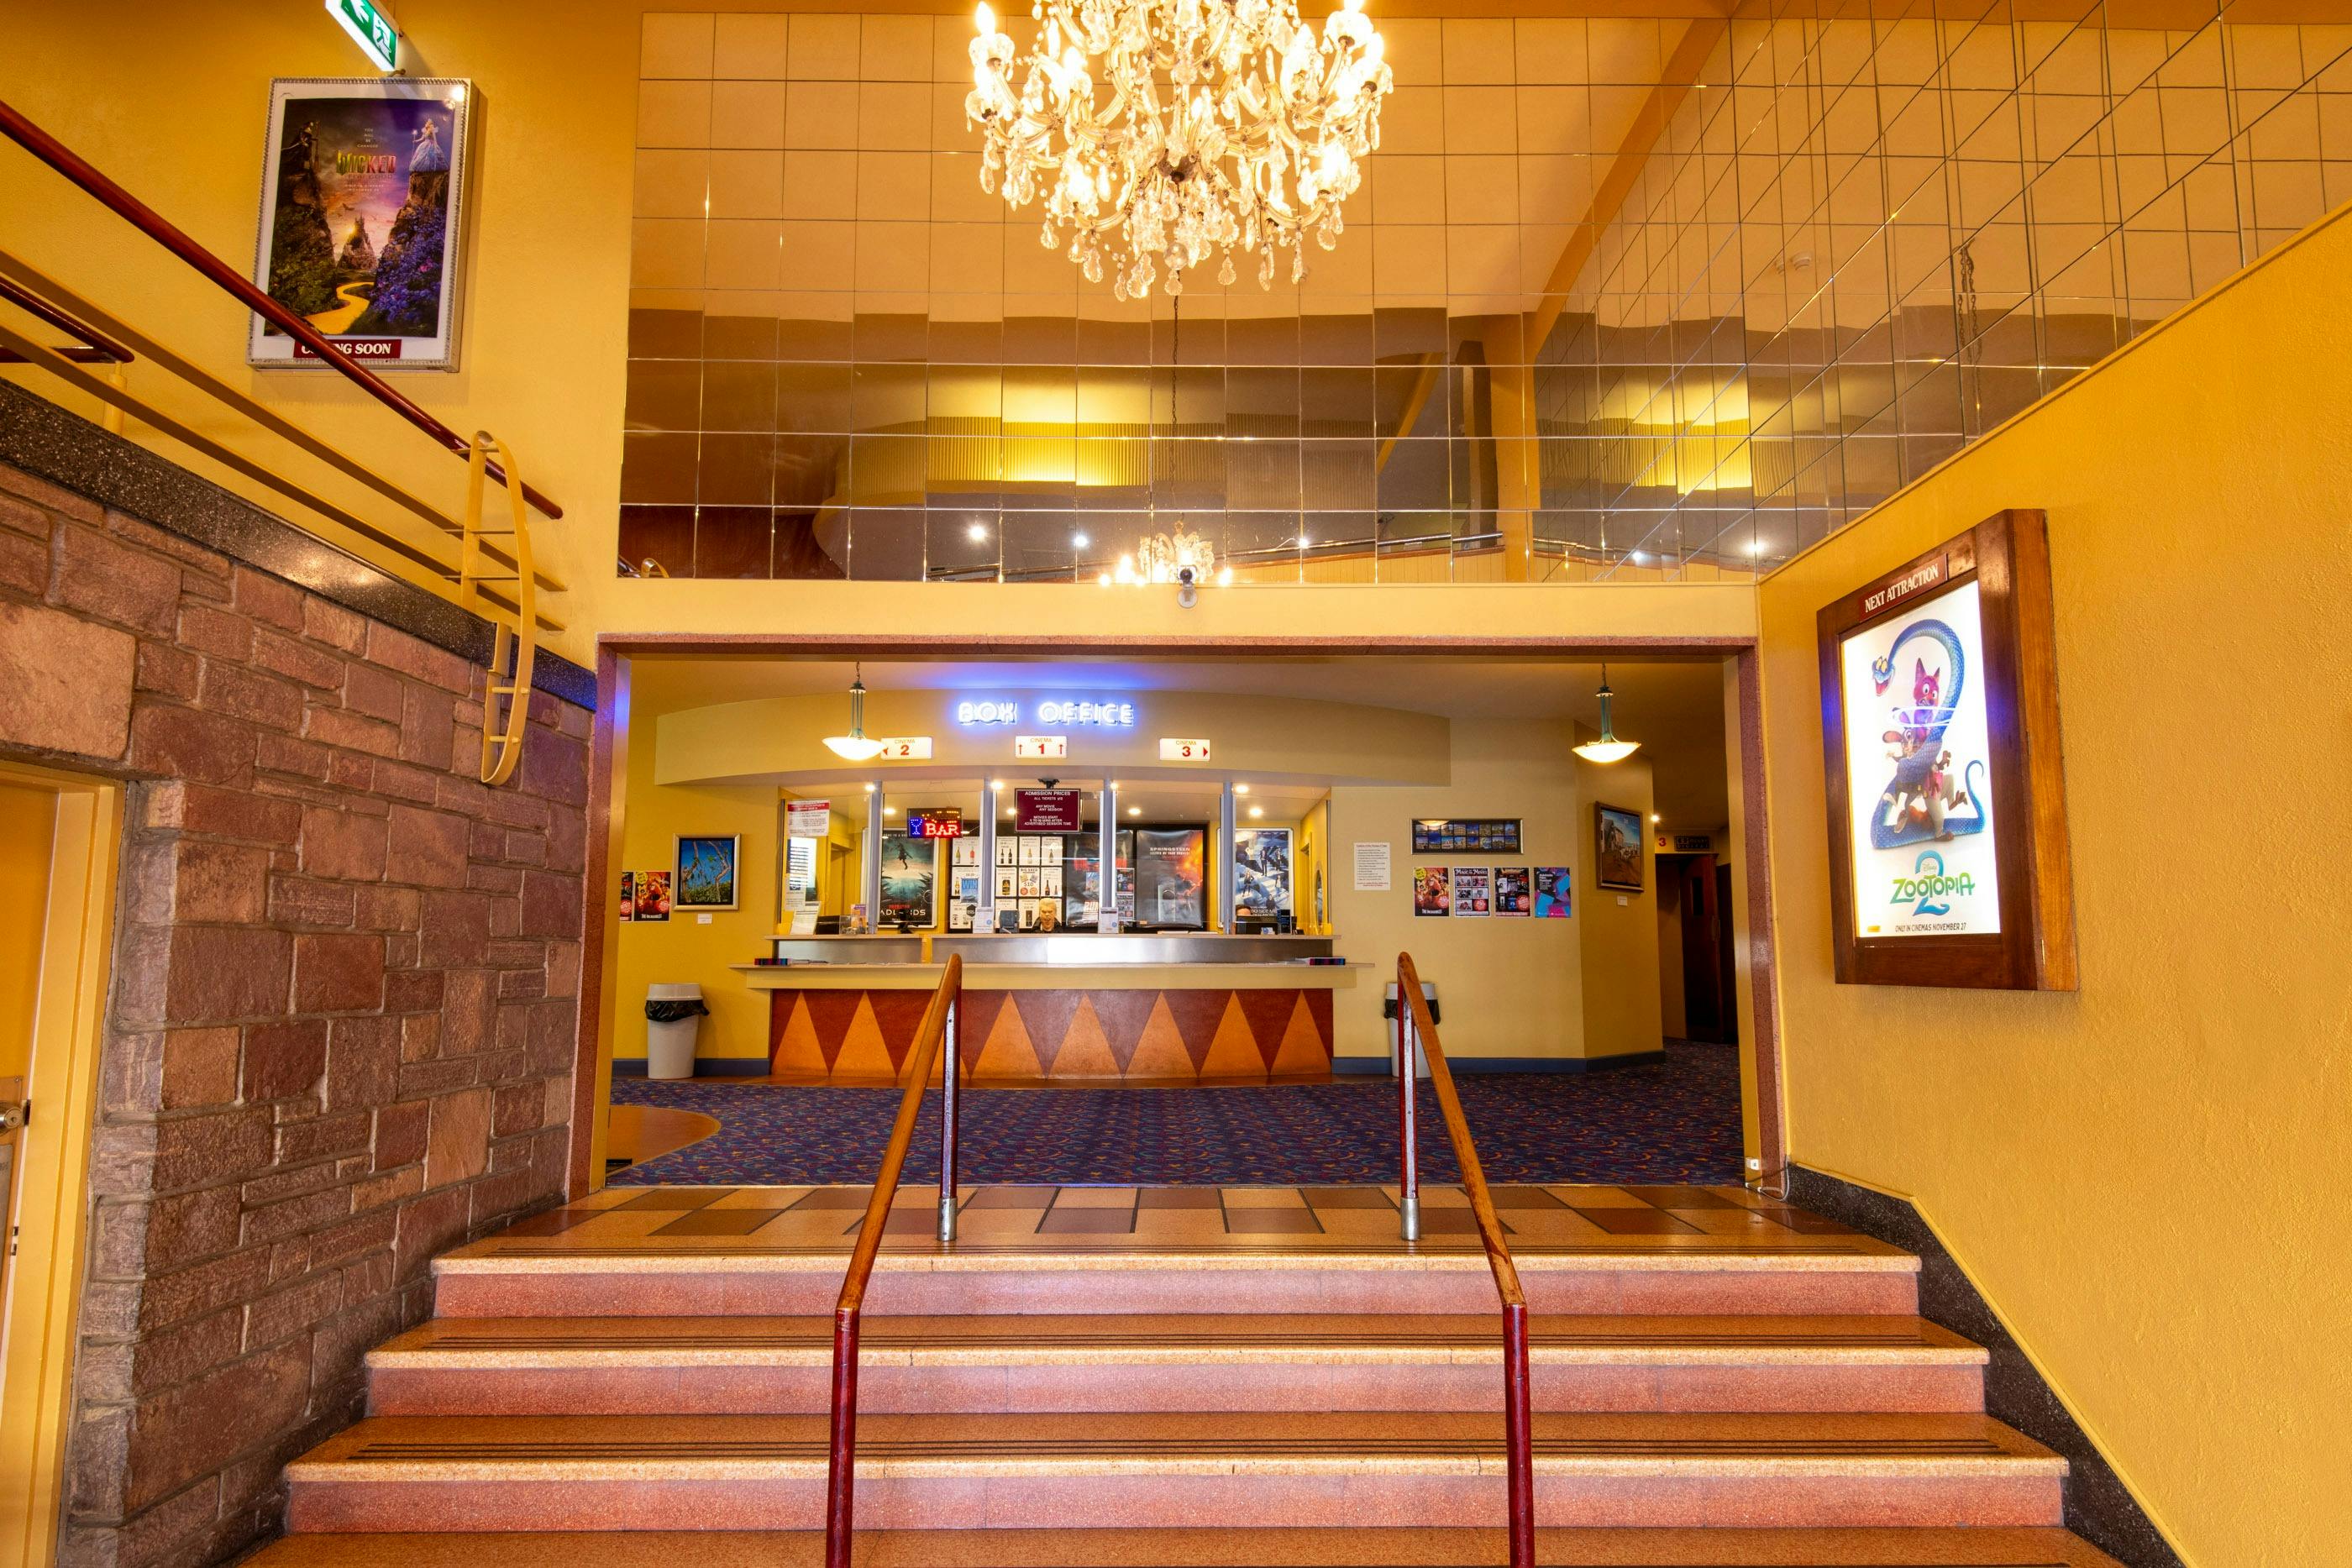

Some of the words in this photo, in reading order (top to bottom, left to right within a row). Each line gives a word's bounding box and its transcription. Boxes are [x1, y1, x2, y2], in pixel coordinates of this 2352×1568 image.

[336, 149, 396, 176] WICKED
[354, 343, 391, 354] SOON
[1865, 590, 1886, 613] NEXT
[1887, 564, 1939, 602] ATTRACTION
[958, 702, 1017, 725] BOX
[1038, 702, 1134, 726] OFFICE
[900, 744, 909, 756] 2
[1038, 744, 1045, 754] 1
[1182, 746, 1191, 758] 3
[926, 823, 959, 836] BAR
[1658, 836, 1667, 847] 3
[1890, 872, 1975, 904] ZOOTOPIA
[1913, 850, 1950, 916] 2
[1961, 922, 1966, 931] 27
